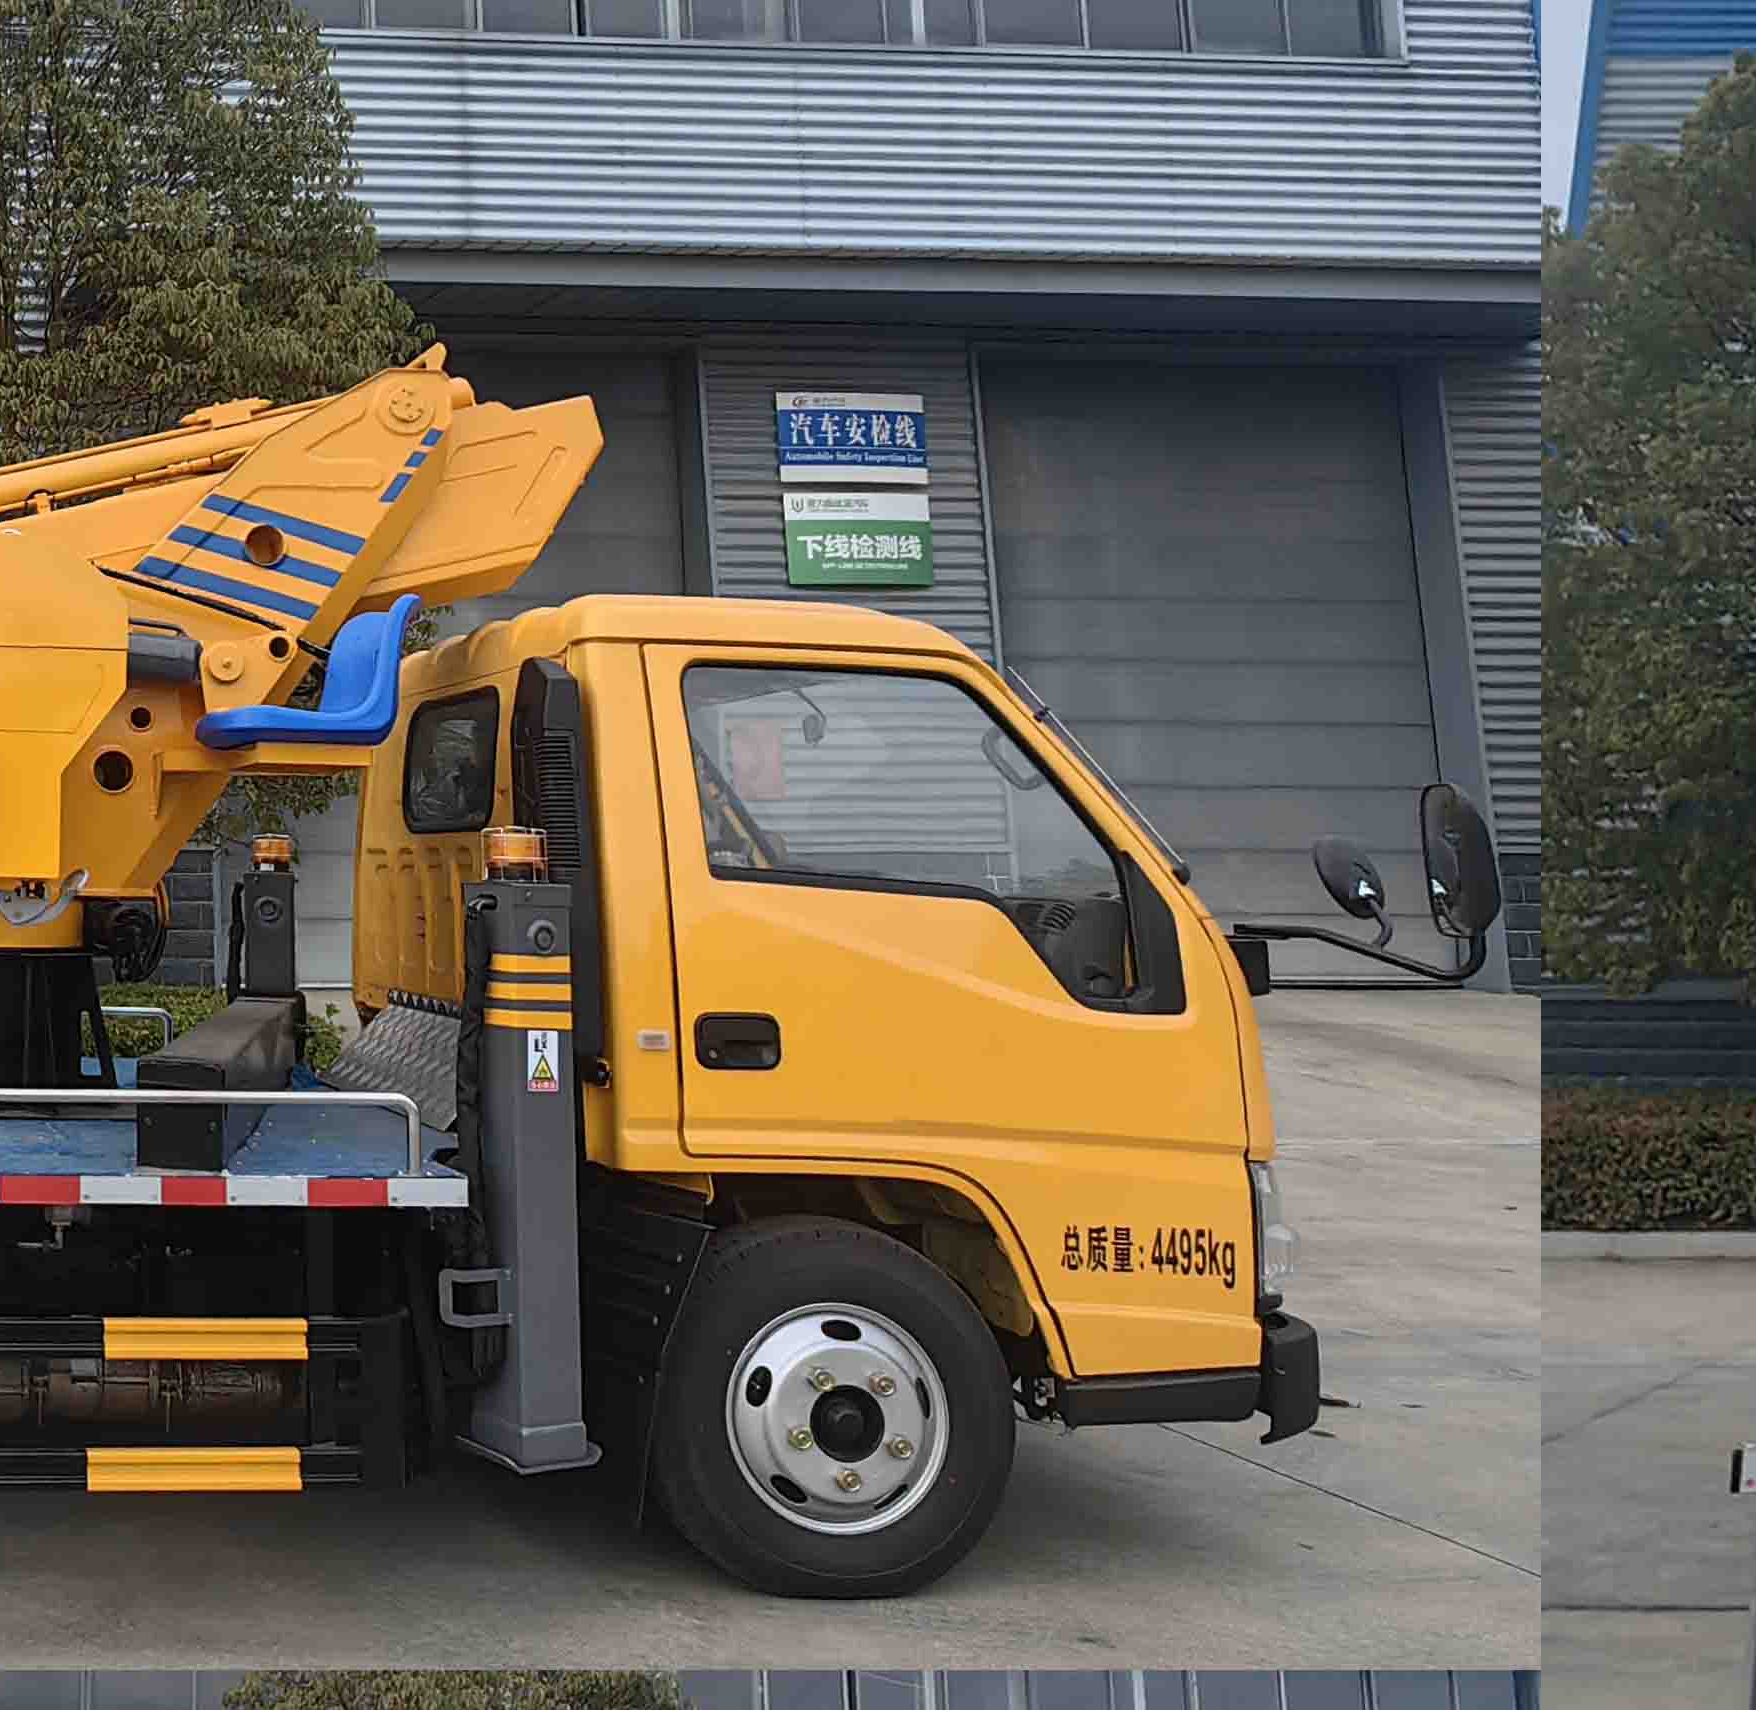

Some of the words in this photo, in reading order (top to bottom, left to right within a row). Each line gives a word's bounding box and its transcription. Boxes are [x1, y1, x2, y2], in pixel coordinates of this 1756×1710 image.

[790, 413, 917, 448] 汽车安检线
[796, 534, 924, 560] 下线检测线
[1061, 1225, 1236, 1289] 总质量:4495kg
